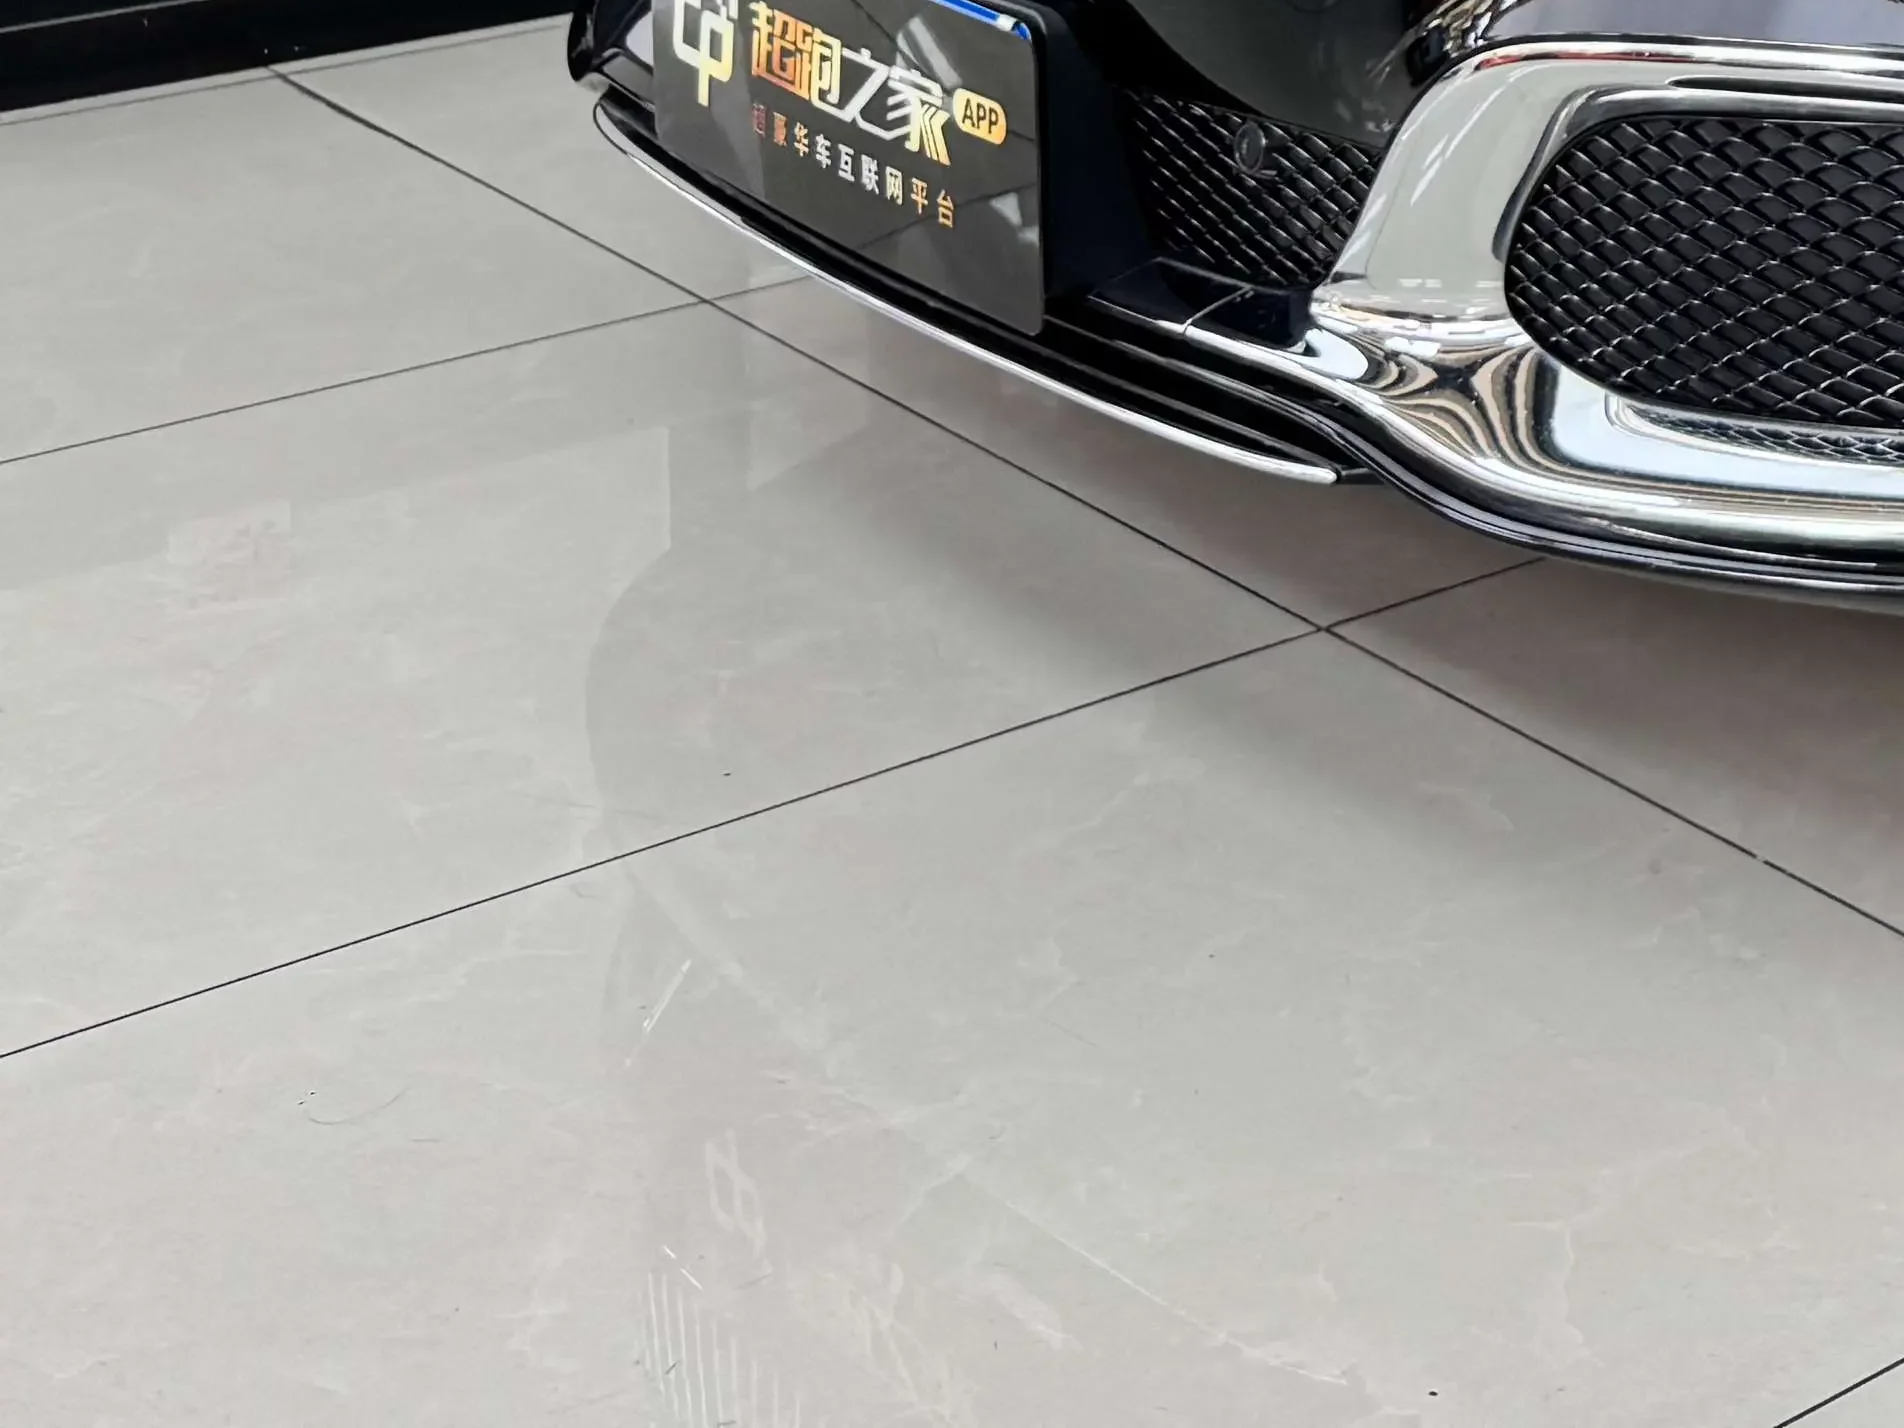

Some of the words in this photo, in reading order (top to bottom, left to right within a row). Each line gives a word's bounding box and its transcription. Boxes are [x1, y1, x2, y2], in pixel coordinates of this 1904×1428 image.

[749, 1, 951, 166] 超跑之家
[961, 97, 999, 135] APP
